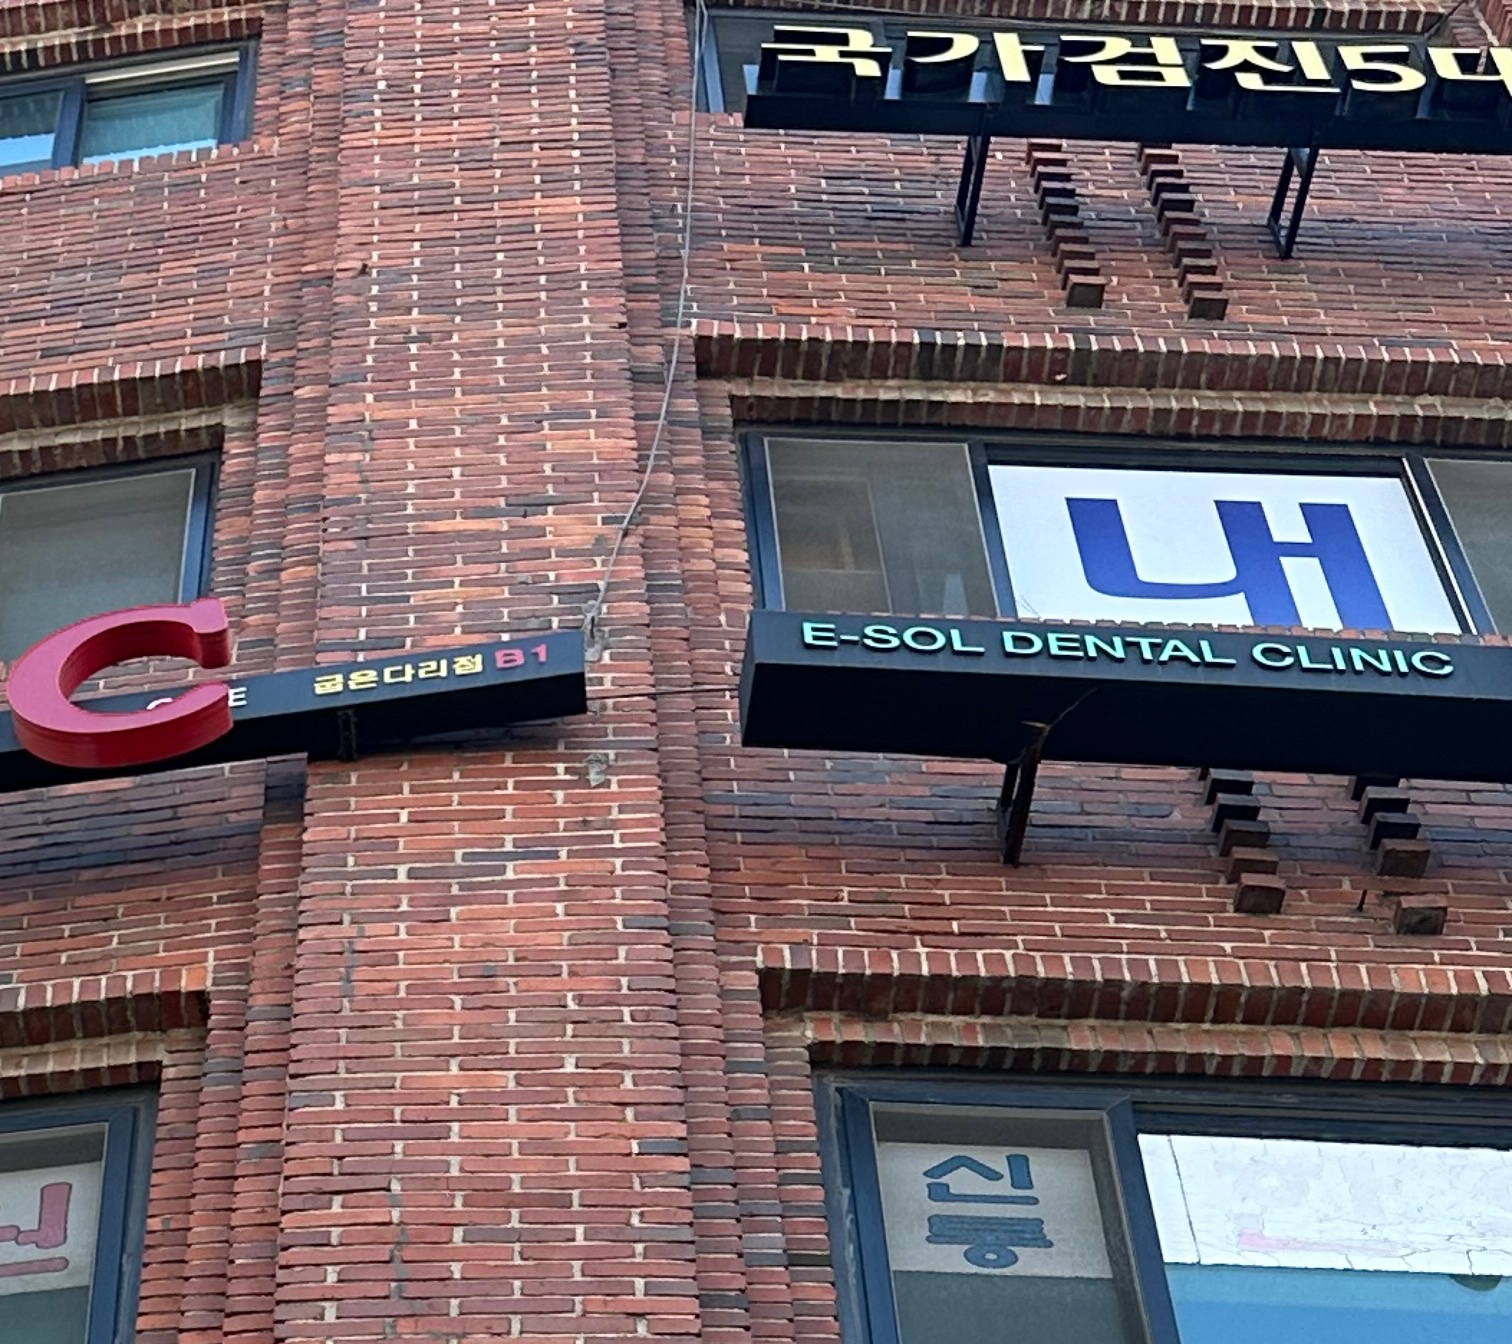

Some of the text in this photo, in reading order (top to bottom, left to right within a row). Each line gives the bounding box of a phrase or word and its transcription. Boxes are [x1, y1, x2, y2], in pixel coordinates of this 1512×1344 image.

[313, 652, 484, 696] 굽은다리점
[494, 643, 549, 669] B1
[802, 621, 1456, 676] E-SOL DENTAL CLINIC
